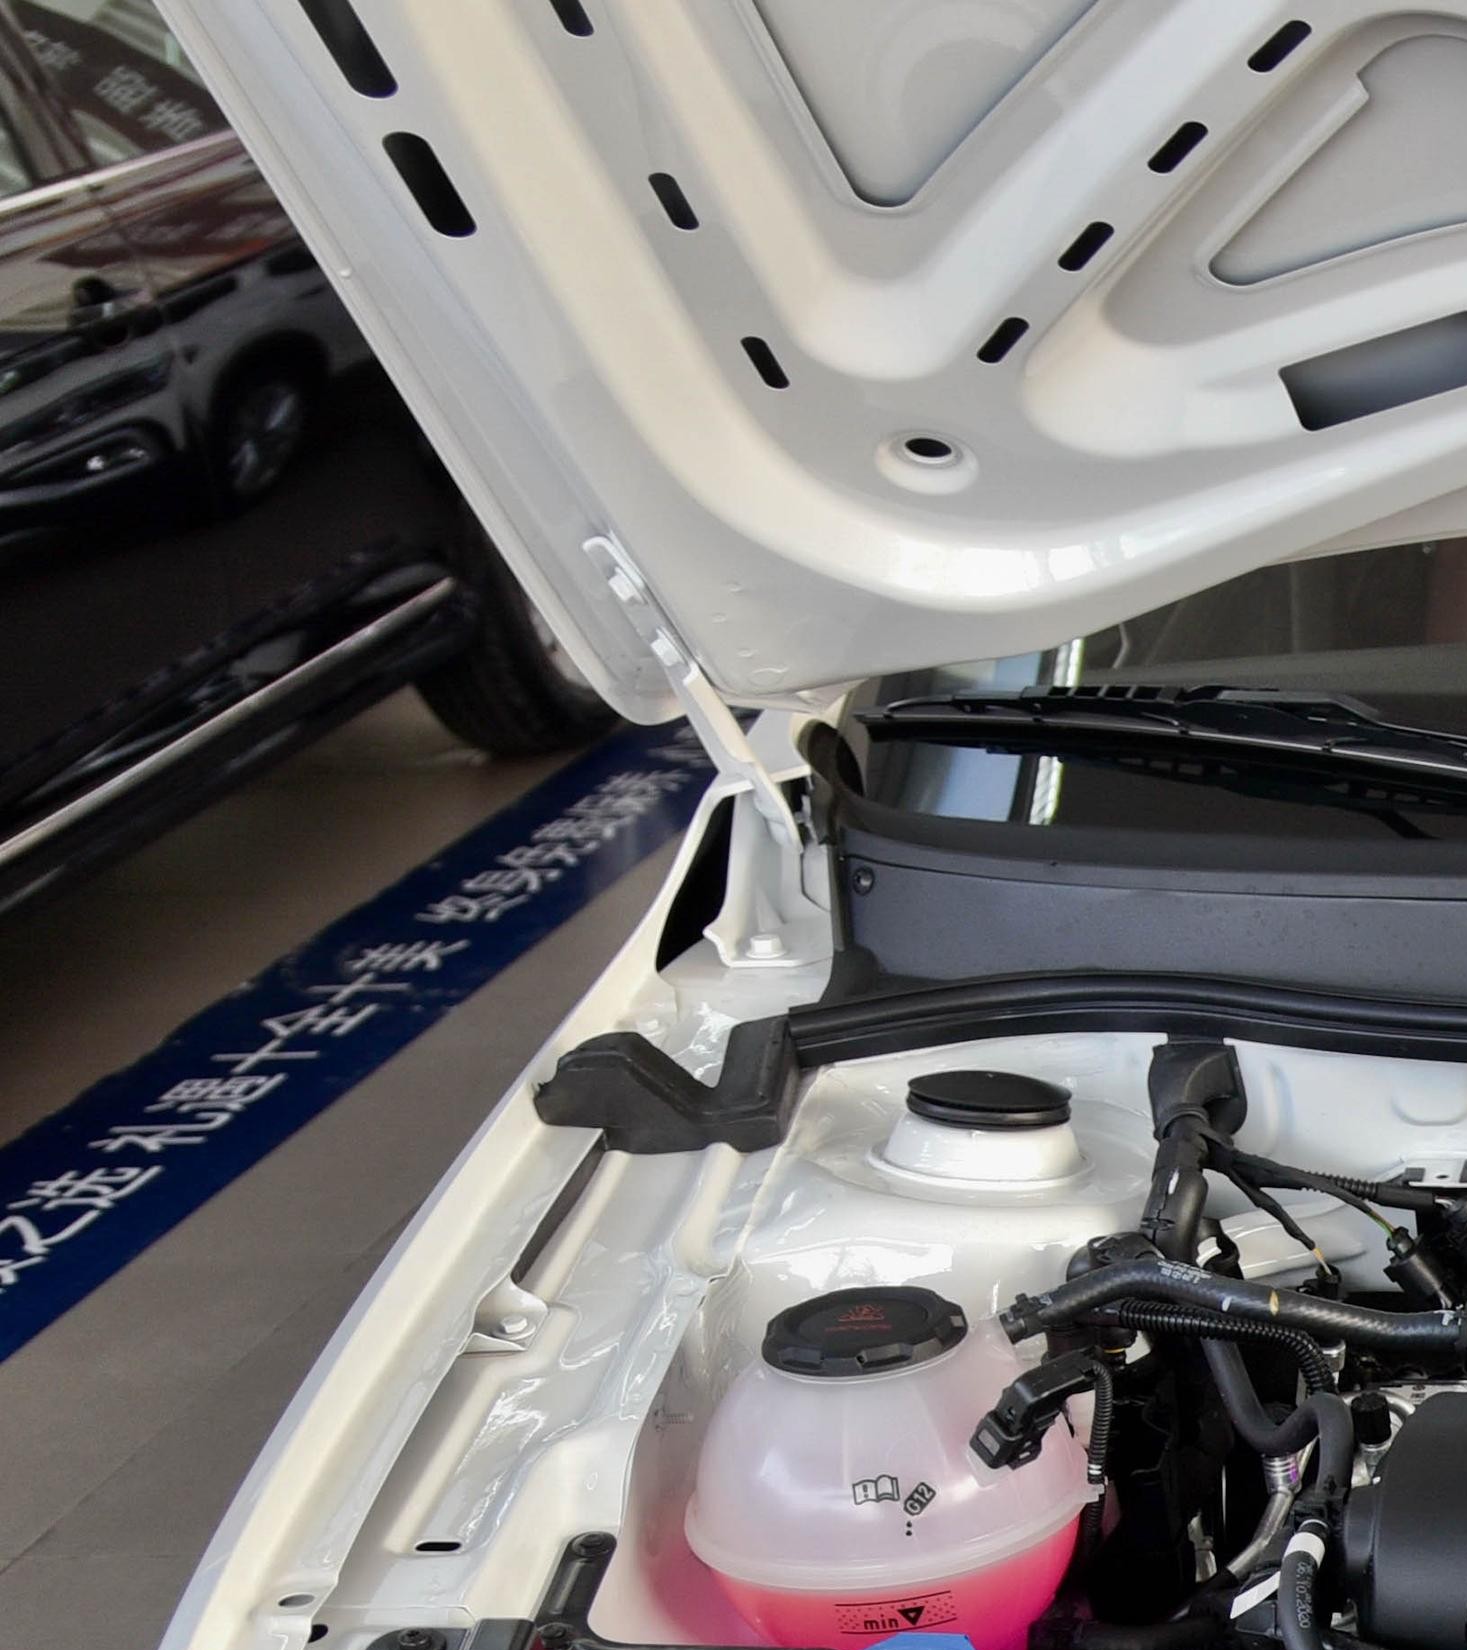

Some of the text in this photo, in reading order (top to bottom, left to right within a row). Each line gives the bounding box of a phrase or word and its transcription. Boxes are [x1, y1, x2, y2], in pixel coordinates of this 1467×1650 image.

[89, 938, 470, 1152] 礼遇十全十美
[905, 1484, 933, 1515] G12
[864, 1613, 899, 1630] min
